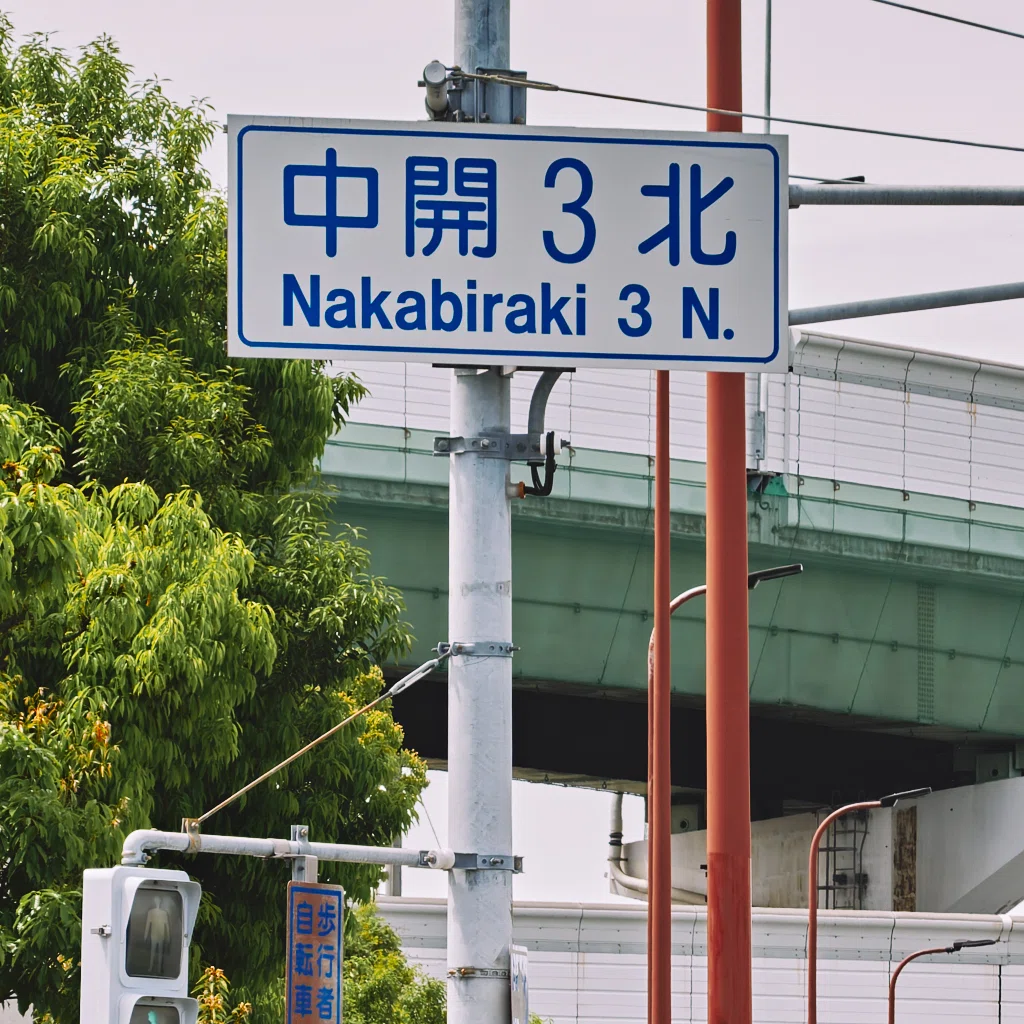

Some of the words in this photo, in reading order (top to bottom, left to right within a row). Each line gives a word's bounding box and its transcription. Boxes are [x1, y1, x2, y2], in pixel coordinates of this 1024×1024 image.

[283, 147, 737, 267] 中開3北
[283, 273, 587, 337] Nakabiraki
[617, 284, 653, 338] 3
[682, 287, 735, 341] N.
[294, 901, 314, 1018] 自転車
[316, 903, 336, 1020] 歩行者
